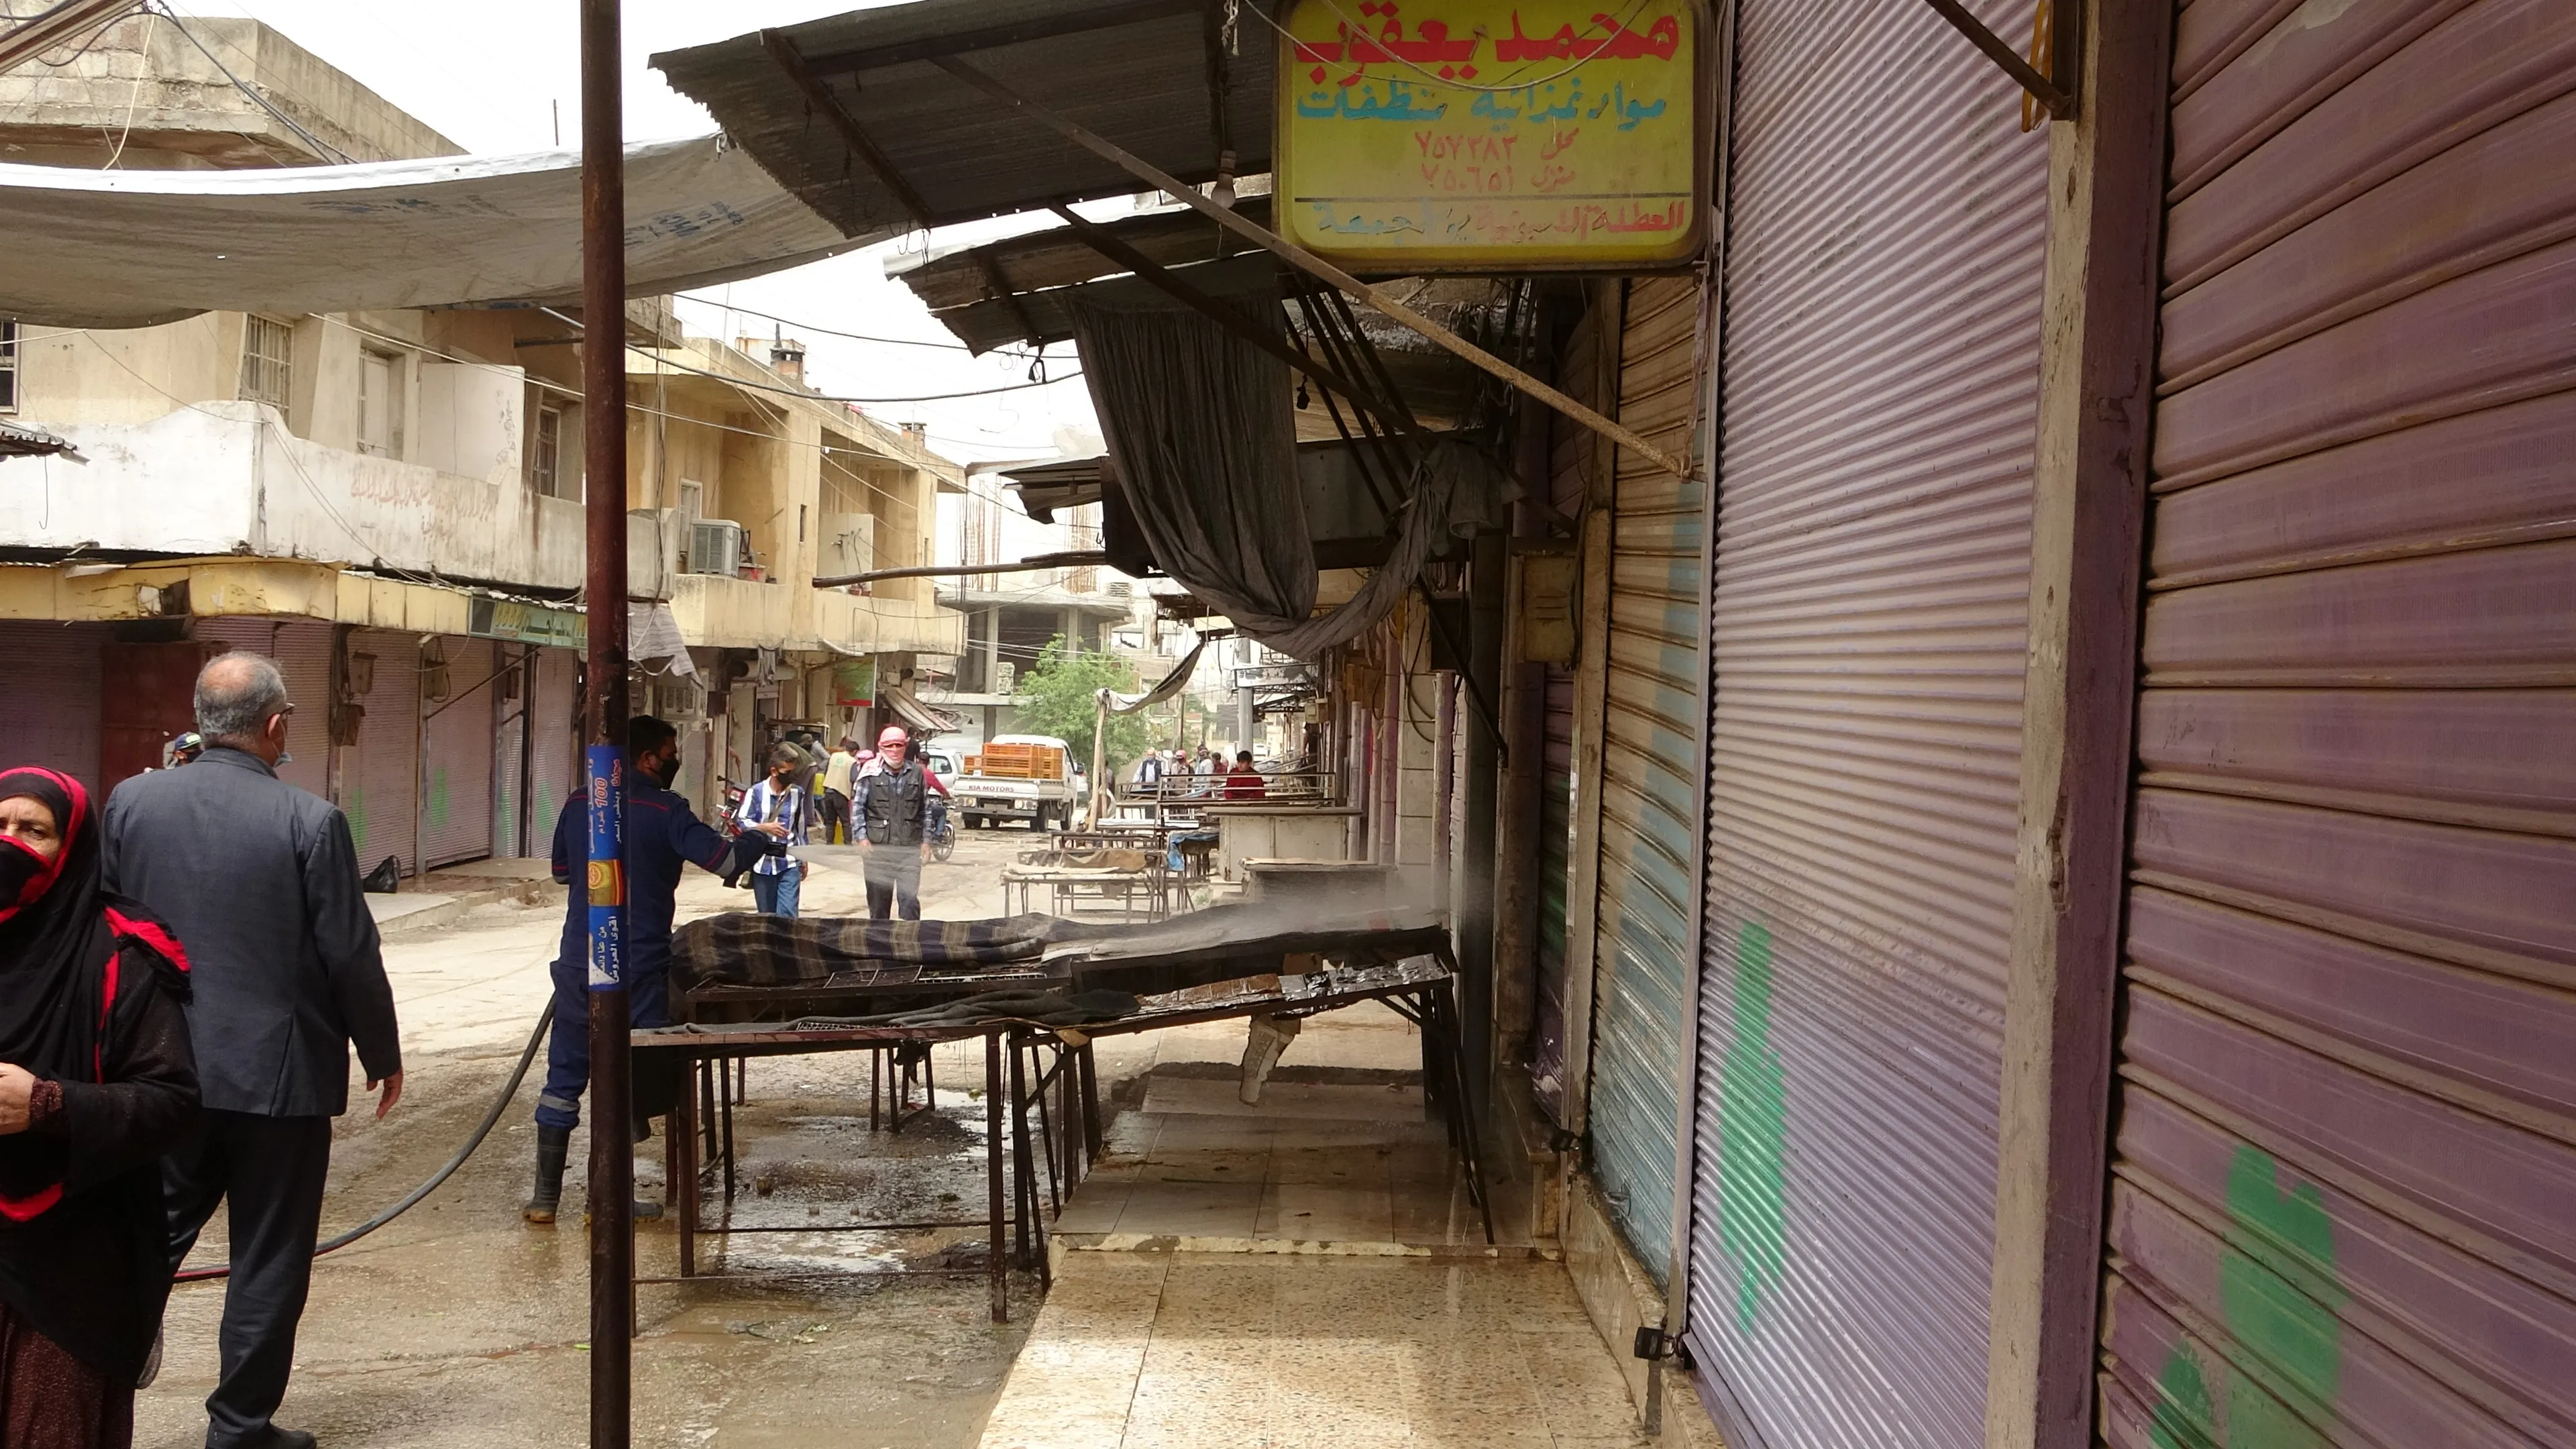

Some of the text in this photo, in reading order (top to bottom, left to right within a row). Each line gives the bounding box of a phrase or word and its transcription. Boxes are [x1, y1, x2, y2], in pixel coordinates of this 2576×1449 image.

[1294, 1, 1680, 87] محمد يعقوب
[1297, 74, 1448, 121] منظفات
[1587, 80, 1667, 131] مواد
[1540, 127, 1580, 160] محل
[1584, 200, 1685, 233] العطلة
